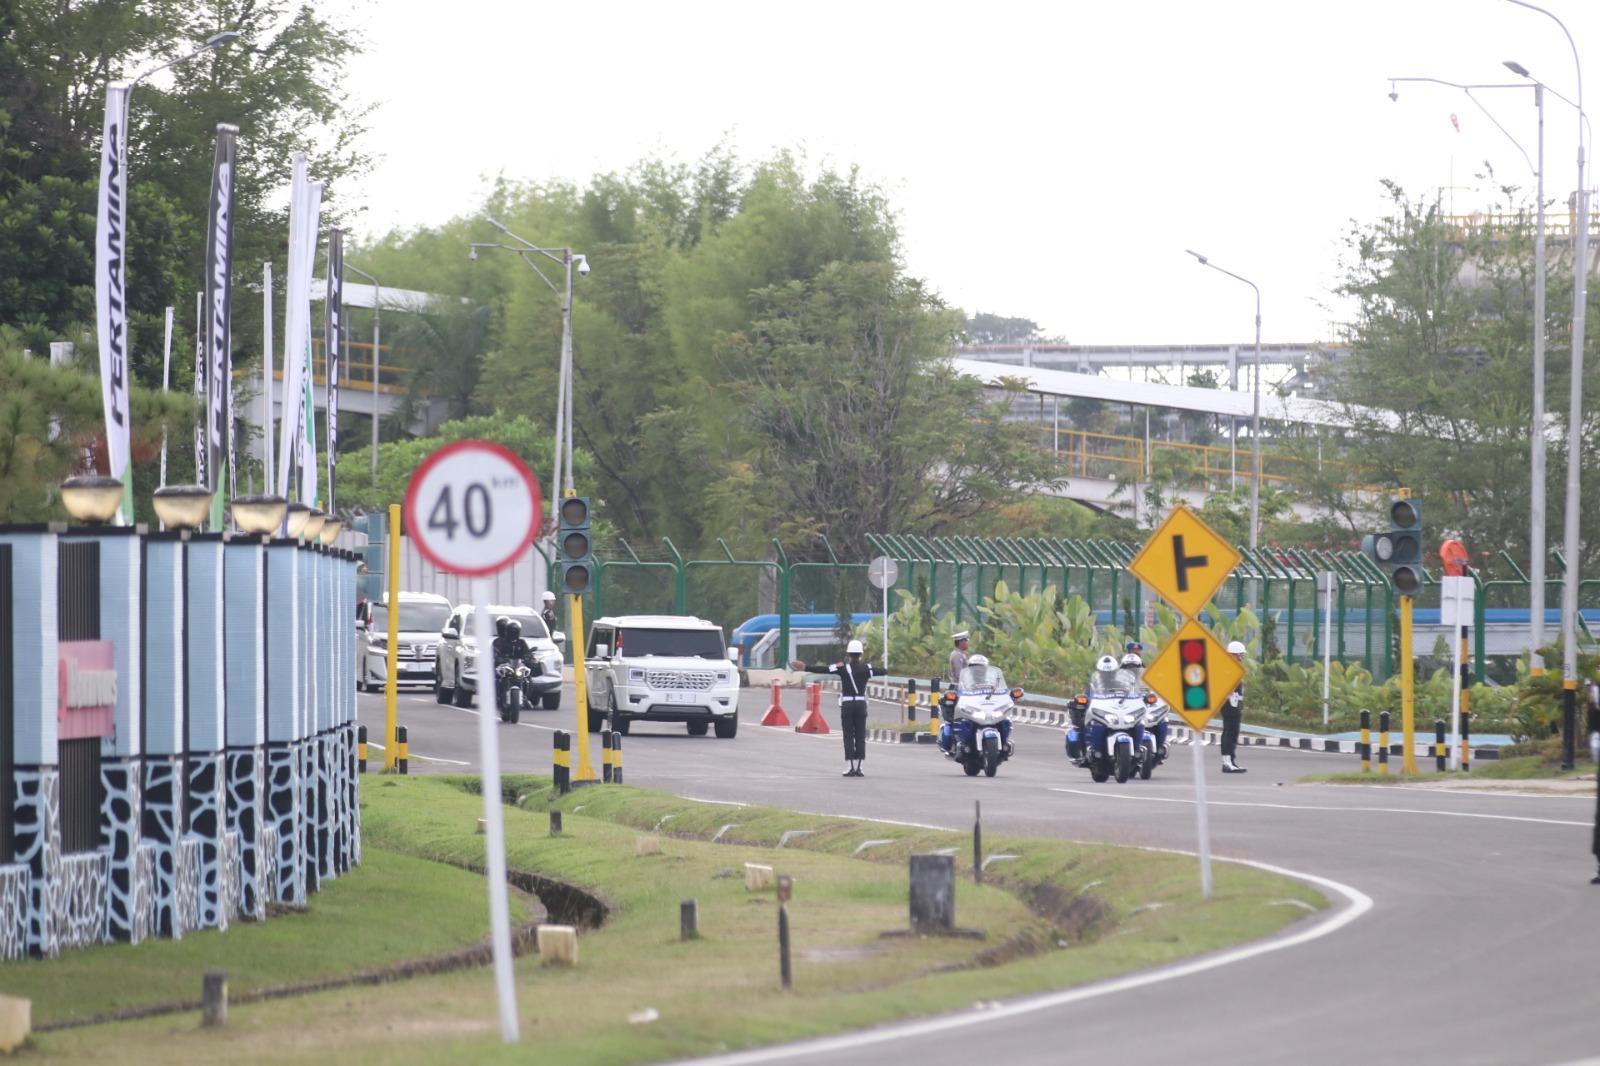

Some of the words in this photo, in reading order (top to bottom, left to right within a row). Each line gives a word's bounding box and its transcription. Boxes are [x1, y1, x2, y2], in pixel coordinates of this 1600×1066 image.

[108, 122, 123, 427] PERTAMINA
[211, 162, 229, 448] PERTAMINA
[428, 482, 492, 541] 40
